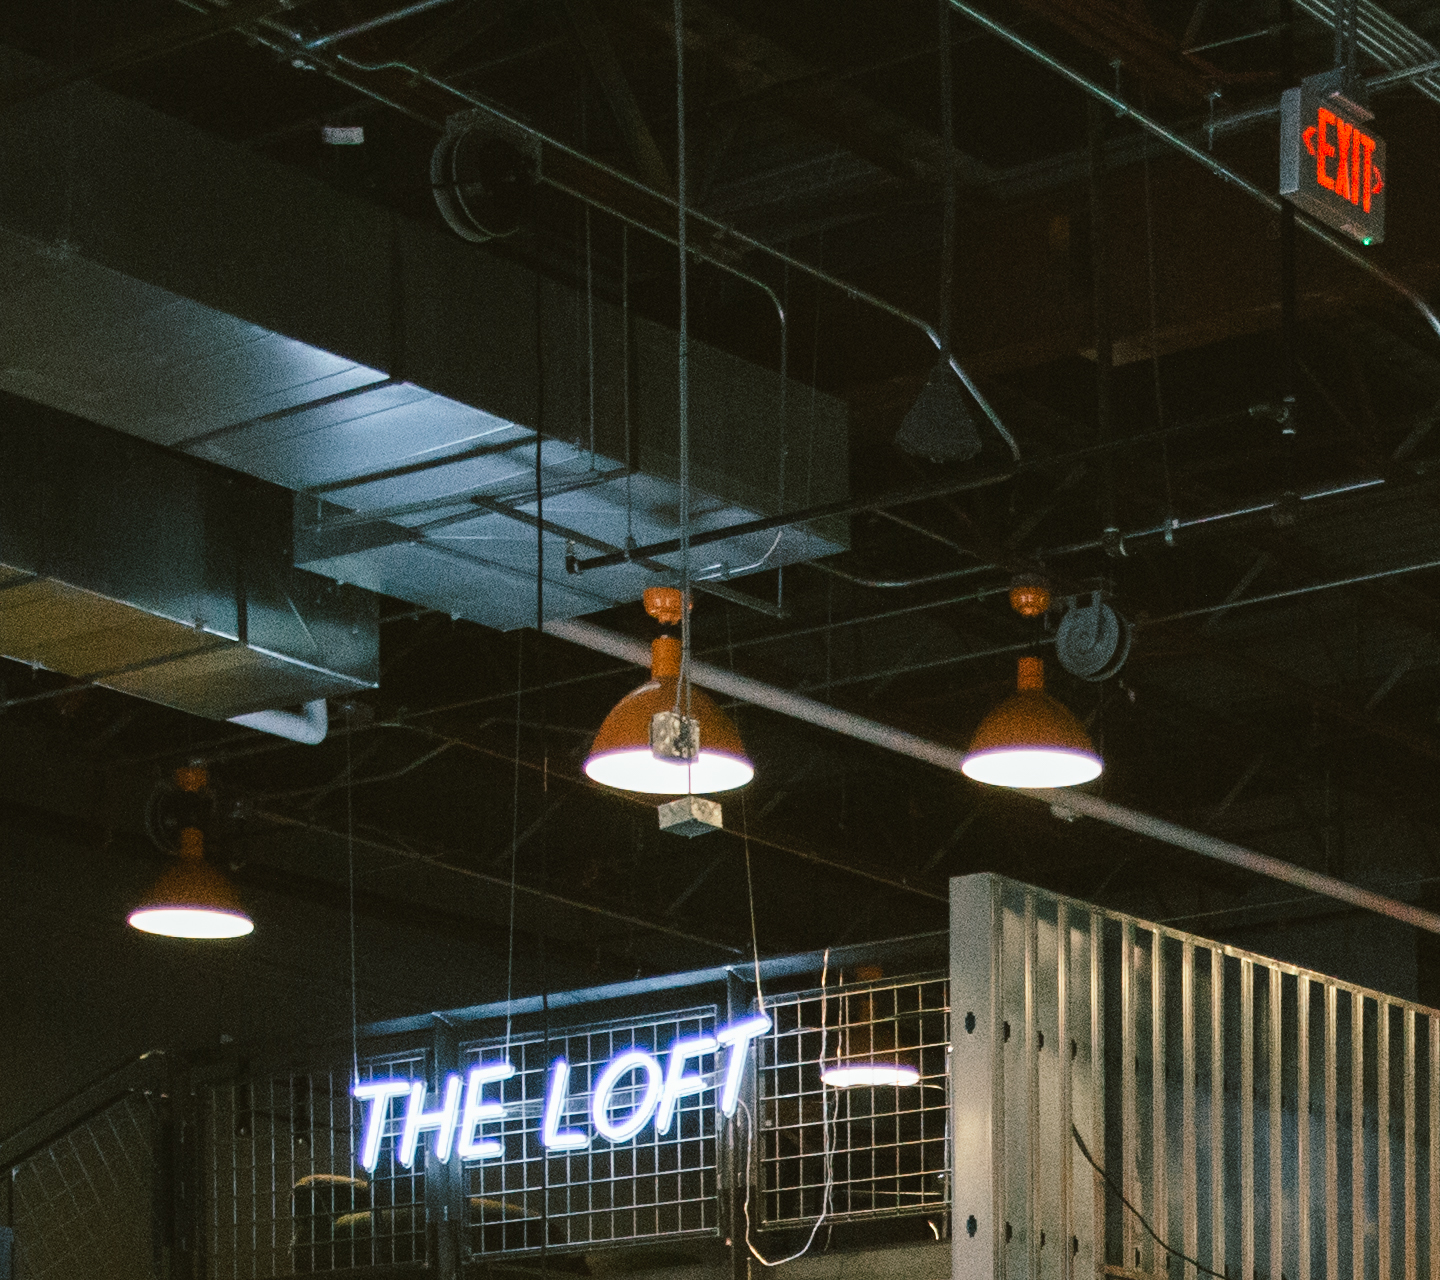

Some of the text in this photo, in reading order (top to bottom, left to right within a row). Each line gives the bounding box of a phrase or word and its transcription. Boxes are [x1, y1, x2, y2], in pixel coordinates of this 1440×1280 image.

[1316, 107, 1376, 213] EXIT
[353, 1013, 773, 1172] THE LOFT
